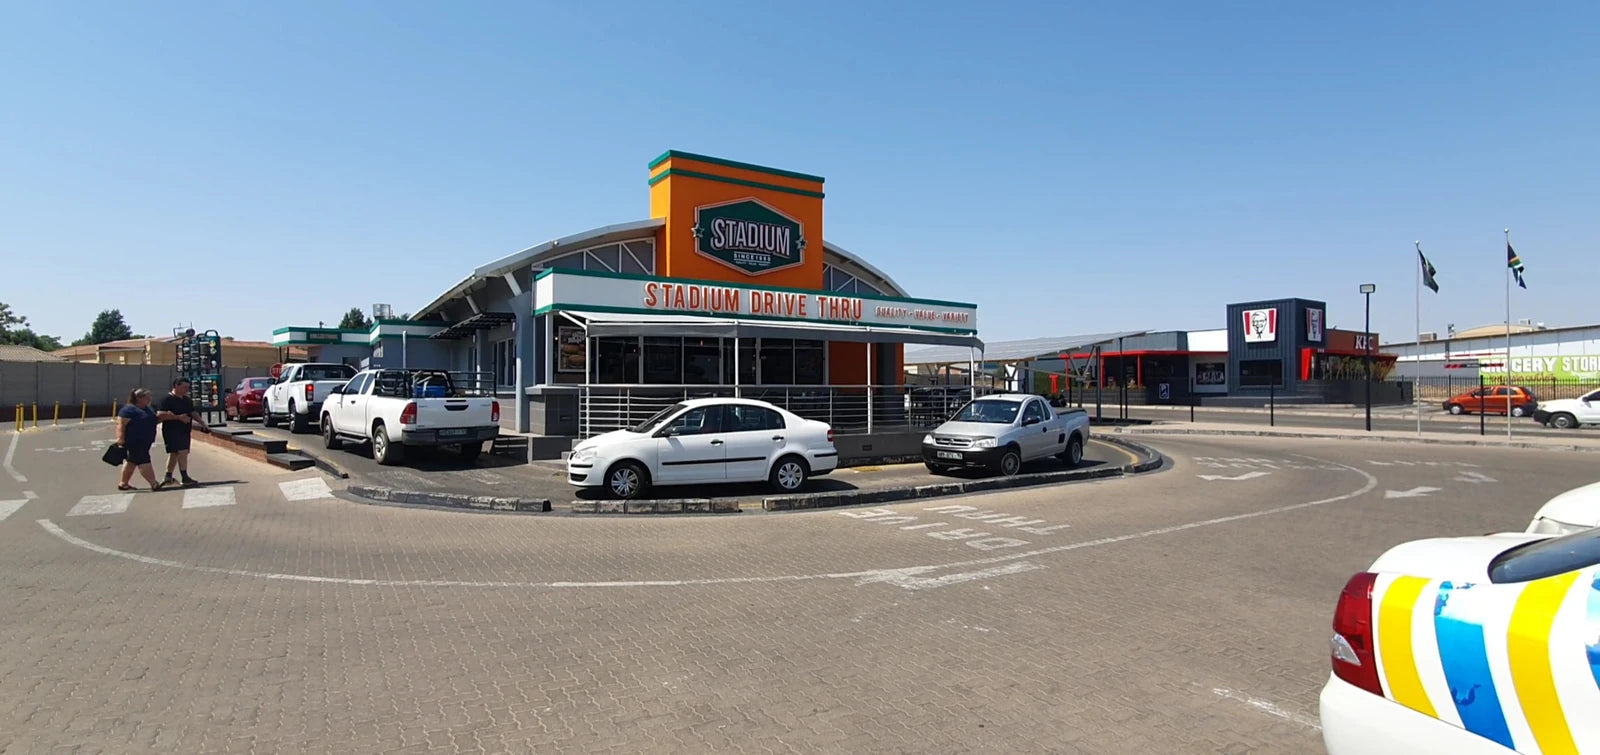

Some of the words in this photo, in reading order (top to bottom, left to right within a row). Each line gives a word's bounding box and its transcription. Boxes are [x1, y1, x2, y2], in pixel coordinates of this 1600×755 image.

[711, 217, 790, 258] STADIUM
[645, 282, 740, 312] STADIUM
[750, 291, 808, 316] DRIVE
[818, 296, 864, 320] THRU
[876, 304, 907, 319] QUALITY
[914, 308, 936, 321] VALUE
[942, 311, 969, 323] VARIETY
[1355, 334, 1374, 350] KFC
[1480, 357, 1557, 373] GROCERY
[1562, 355, 1600, 372] STOR
[838, 508, 1032, 550] DRIVE
[923, 504, 1071, 535] THRU
